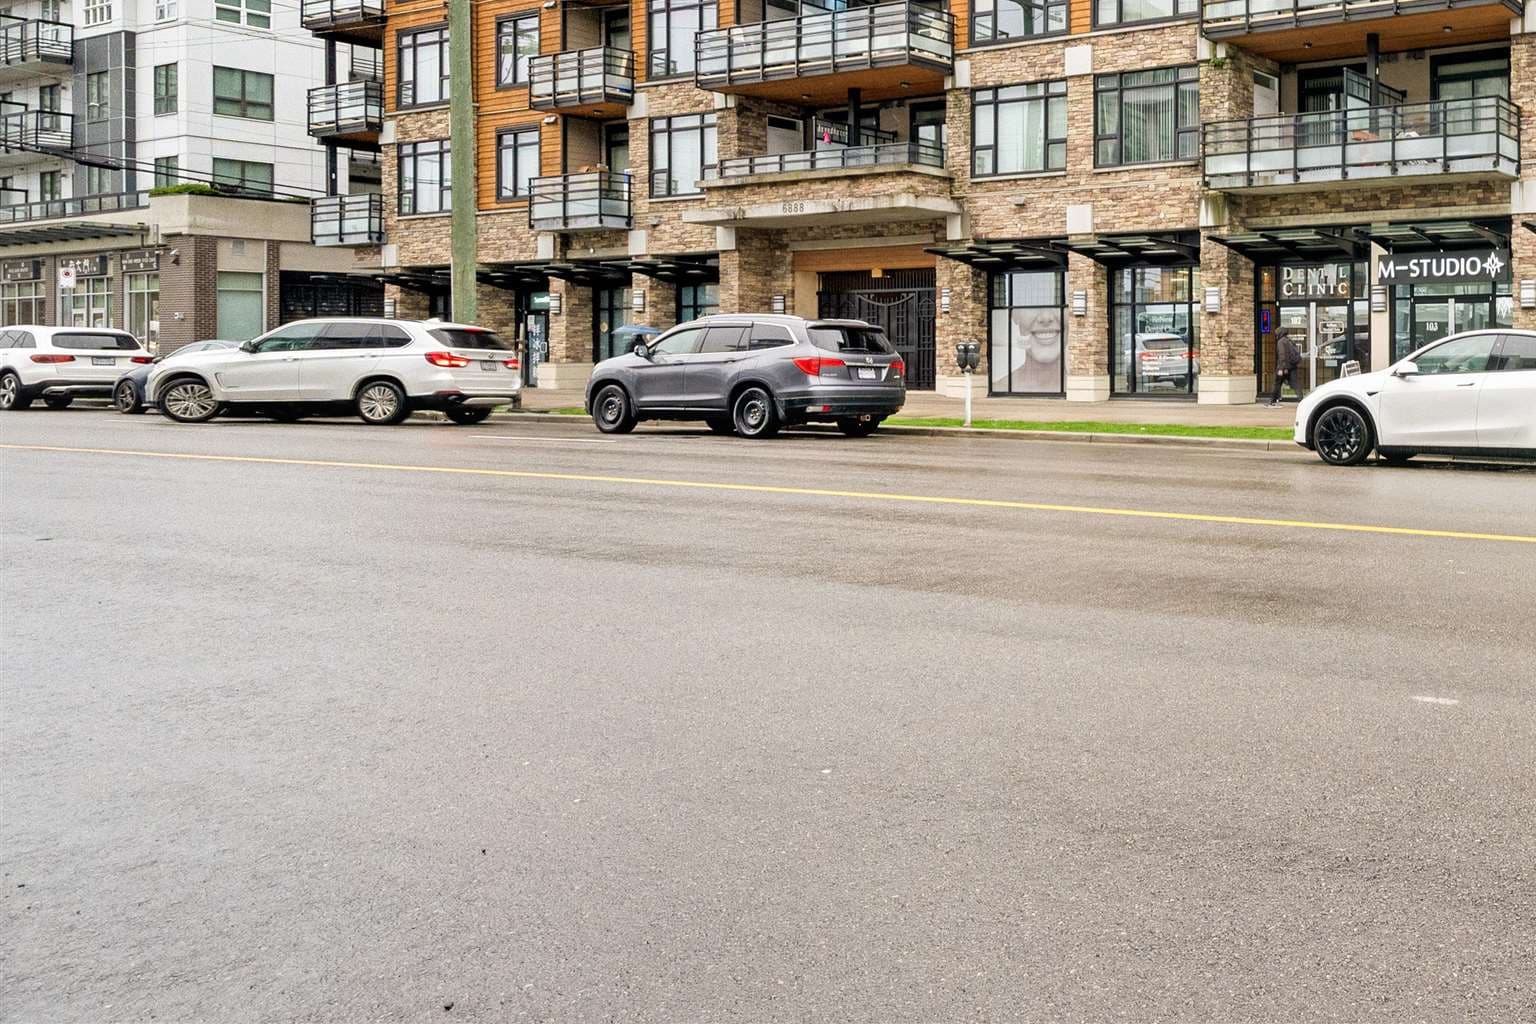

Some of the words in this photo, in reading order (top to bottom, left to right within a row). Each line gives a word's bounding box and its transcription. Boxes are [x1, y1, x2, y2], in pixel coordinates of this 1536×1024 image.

[783, 202, 804, 213] 6888
[1283, 267, 1346, 280] DENTL
[1378, 257, 1481, 278] M-STUDIO
[1283, 282, 1347, 295] CLINIC
[1426, 322, 1438, 331] 103
